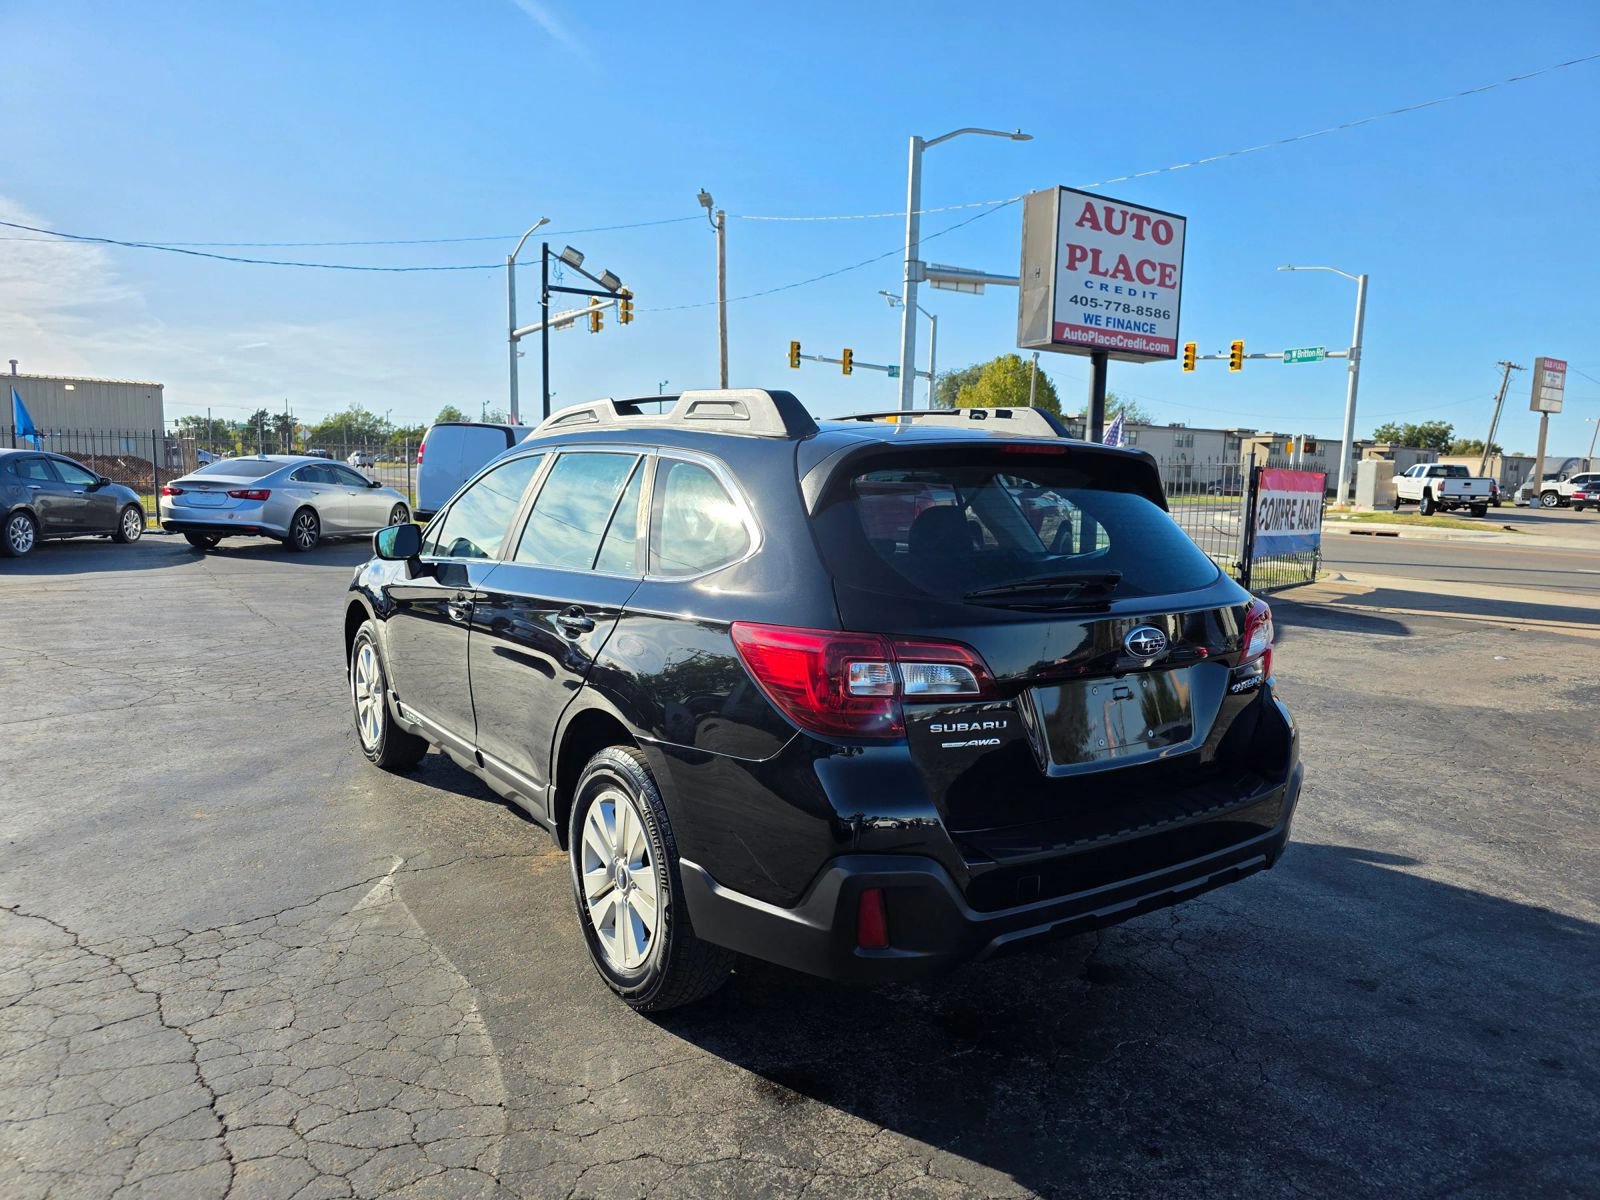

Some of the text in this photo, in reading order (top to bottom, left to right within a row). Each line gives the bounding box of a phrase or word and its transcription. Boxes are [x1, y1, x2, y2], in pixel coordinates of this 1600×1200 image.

[1075, 201, 1174, 246] AUTO
[1065, 243, 1177, 290] PLACE
[1084, 280, 1158, 300] CREDIT
[1069, 294, 1171, 320] 405-778-8586
[1083, 312, 1157, 335] WE FINANCE
[1063, 327, 1170, 353] AutoPlaceCredit.com
[1258, 497, 1297, 531] COMPRE
[929, 720, 1008, 733] SUBARU
